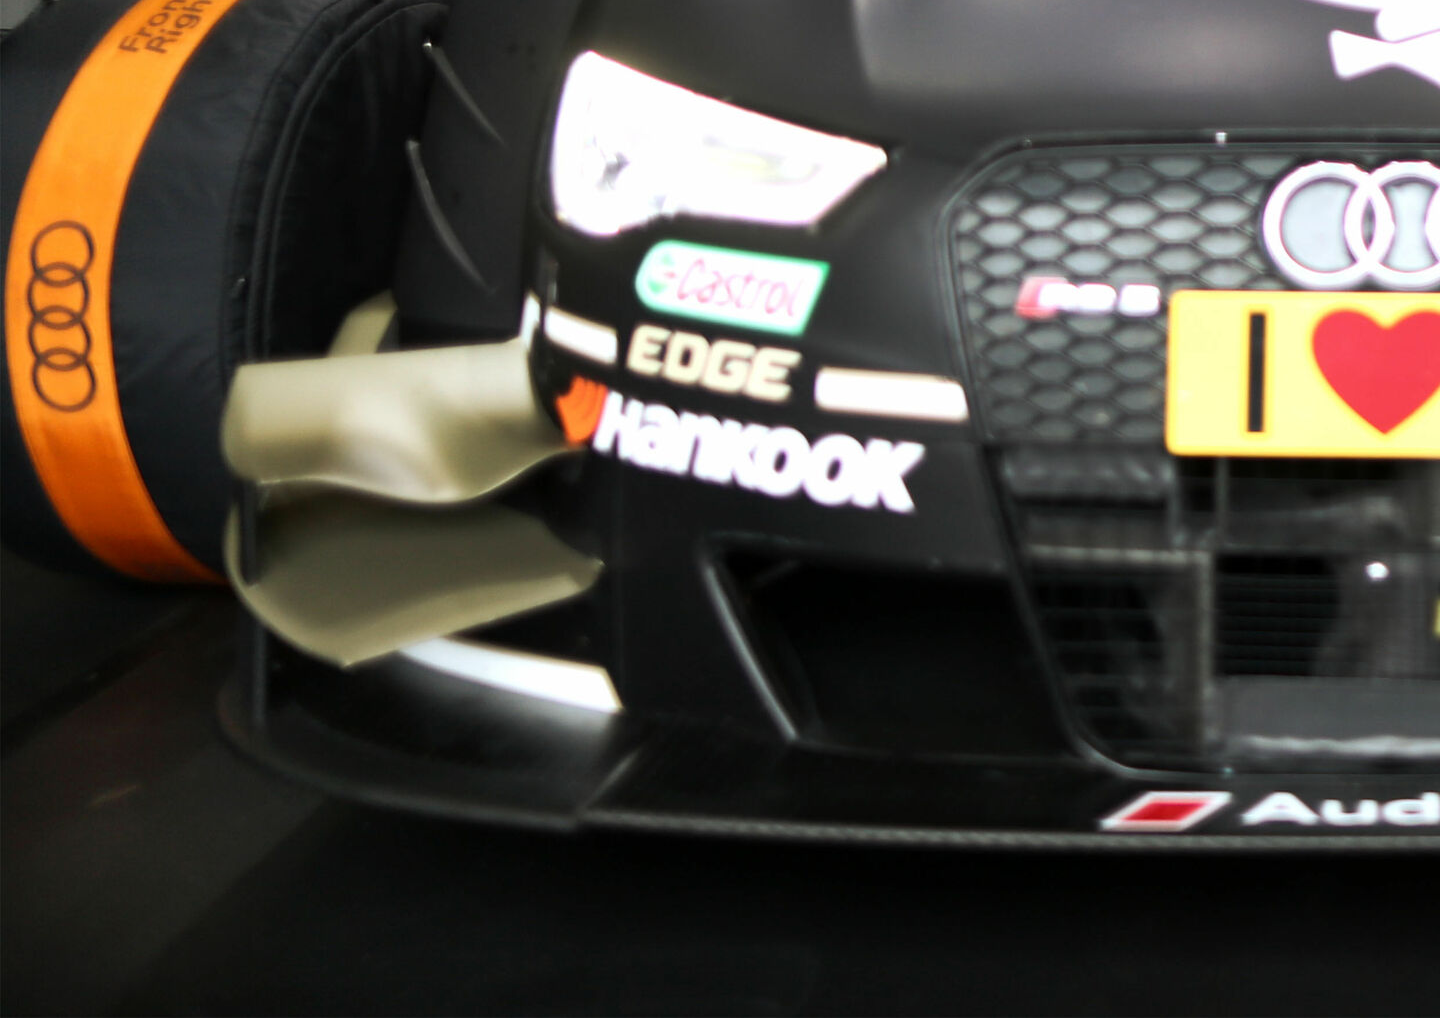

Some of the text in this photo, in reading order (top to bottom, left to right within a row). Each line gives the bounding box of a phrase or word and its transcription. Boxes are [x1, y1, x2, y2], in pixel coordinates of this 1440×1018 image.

[676, 257, 804, 317] Castrol
[627, 324, 802, 401] EDGE
[1247, 312, 1266, 433] I
